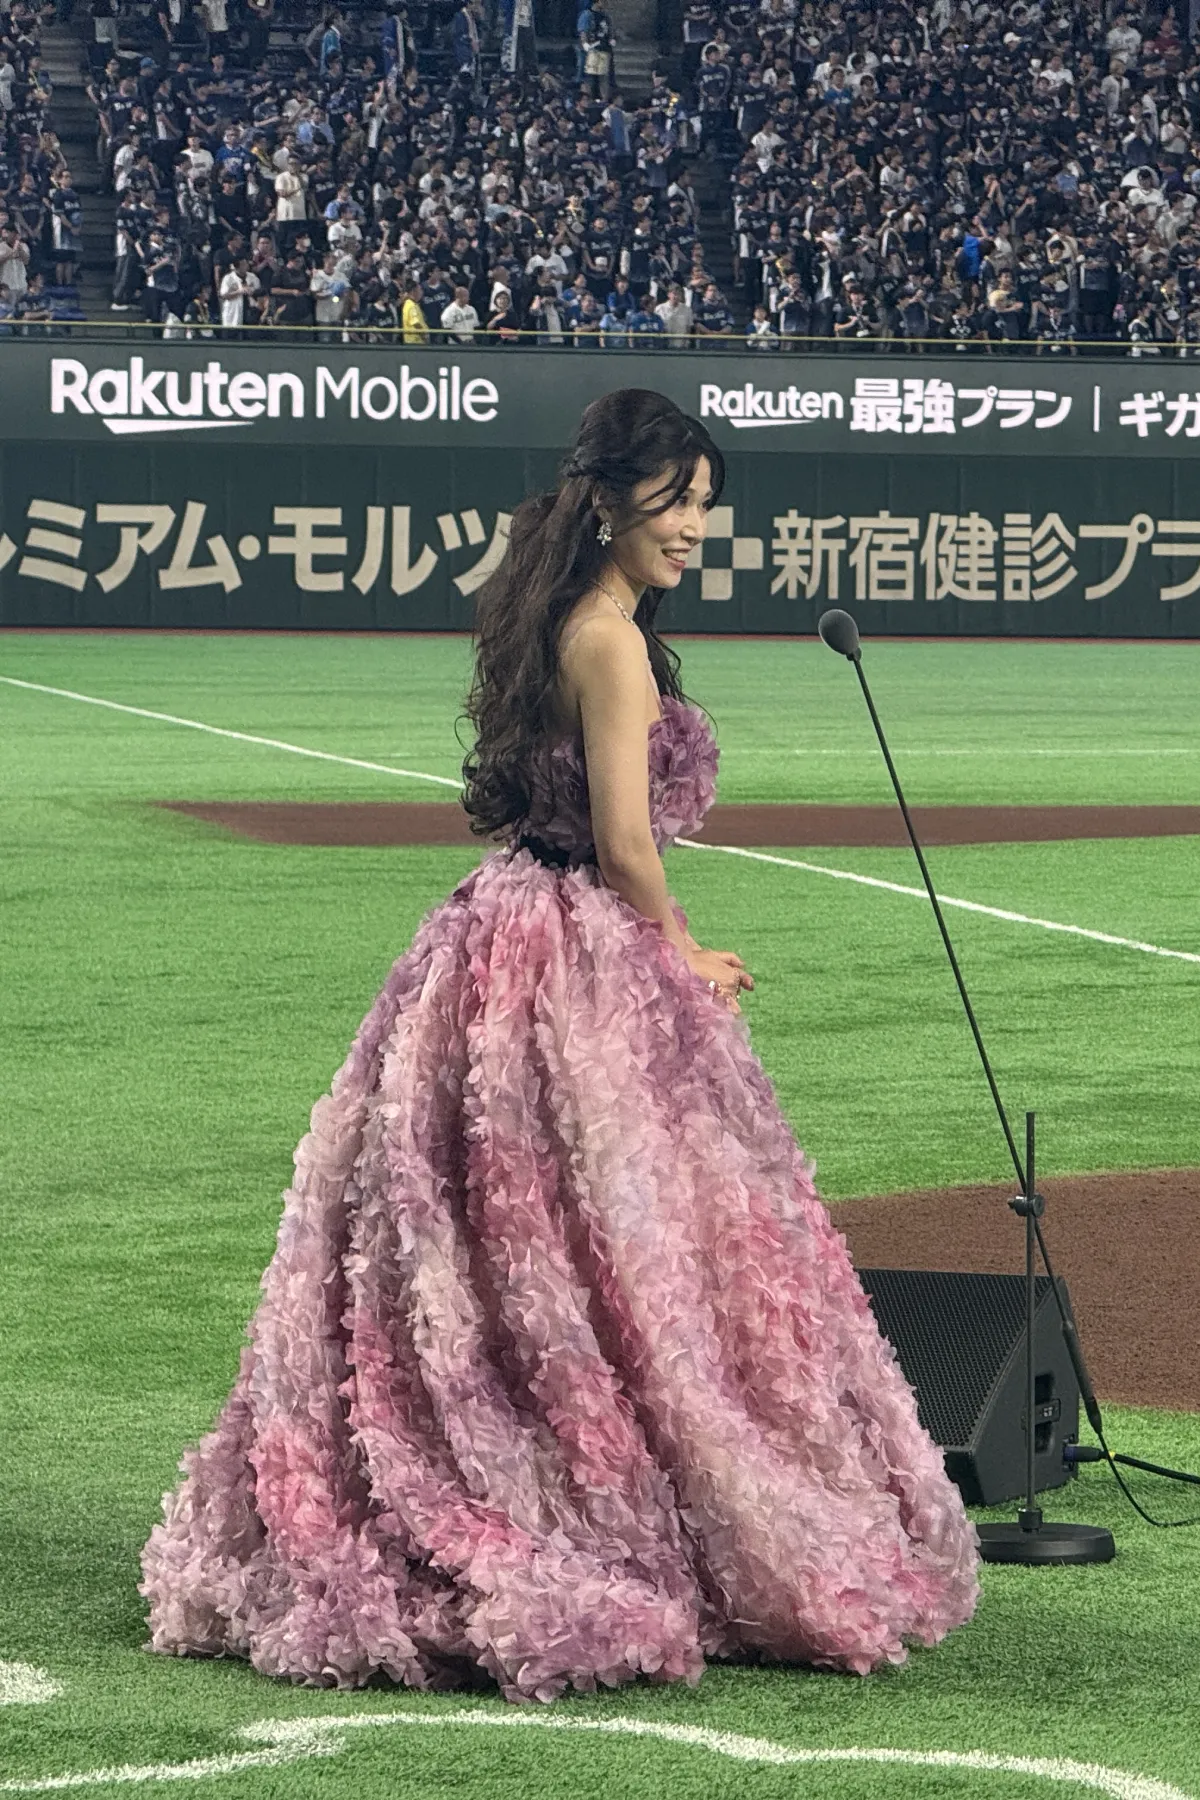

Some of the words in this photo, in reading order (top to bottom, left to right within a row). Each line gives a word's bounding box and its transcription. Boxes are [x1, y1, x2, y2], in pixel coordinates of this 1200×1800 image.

[52, 357, 304, 419] Rakuten
[315, 364, 499, 422] Mobile
[701, 383, 843, 421] Rakuten
[849, 377, 1073, 434] 最強プラン
[0, 499, 514, 596] ミアム・モルツ
